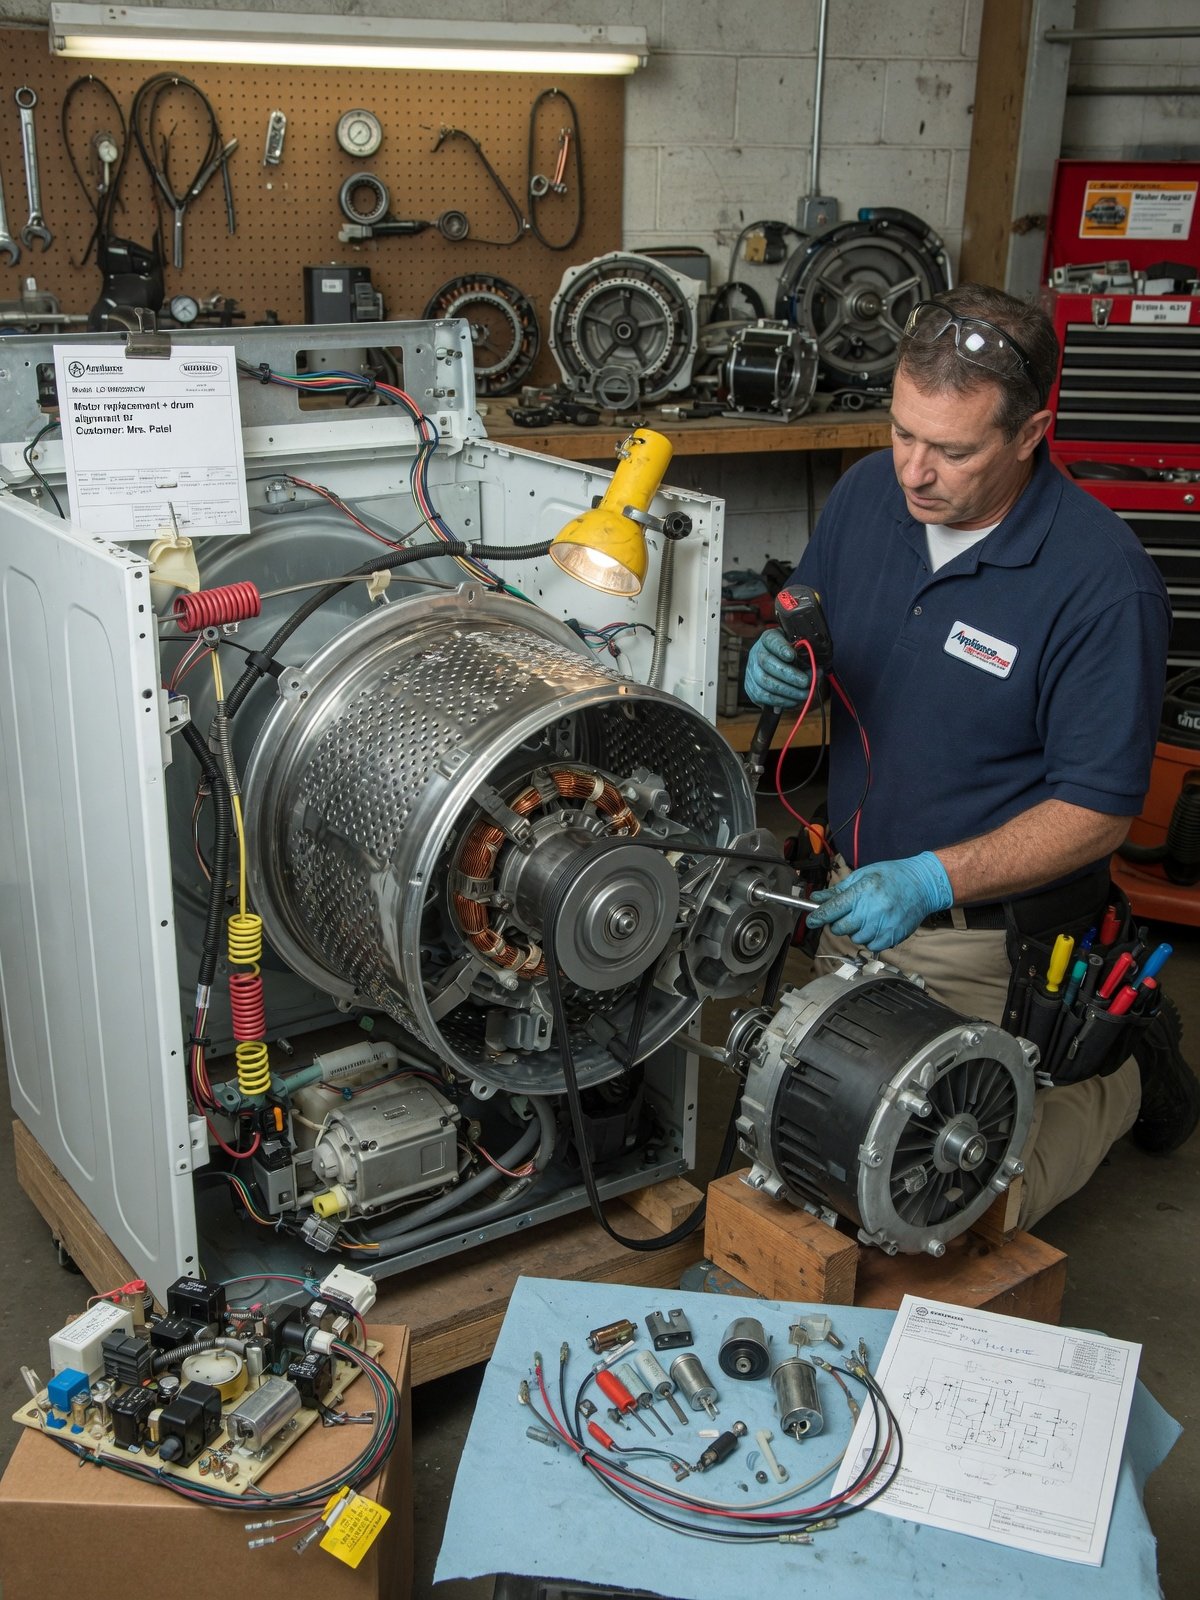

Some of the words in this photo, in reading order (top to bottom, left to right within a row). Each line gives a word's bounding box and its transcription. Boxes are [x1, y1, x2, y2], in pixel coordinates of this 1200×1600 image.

[74, 402, 100, 410] Motor
[171, 401, 194, 409] drum
[76, 426, 124, 435] Customer:
[149, 424, 172, 433] Patel
